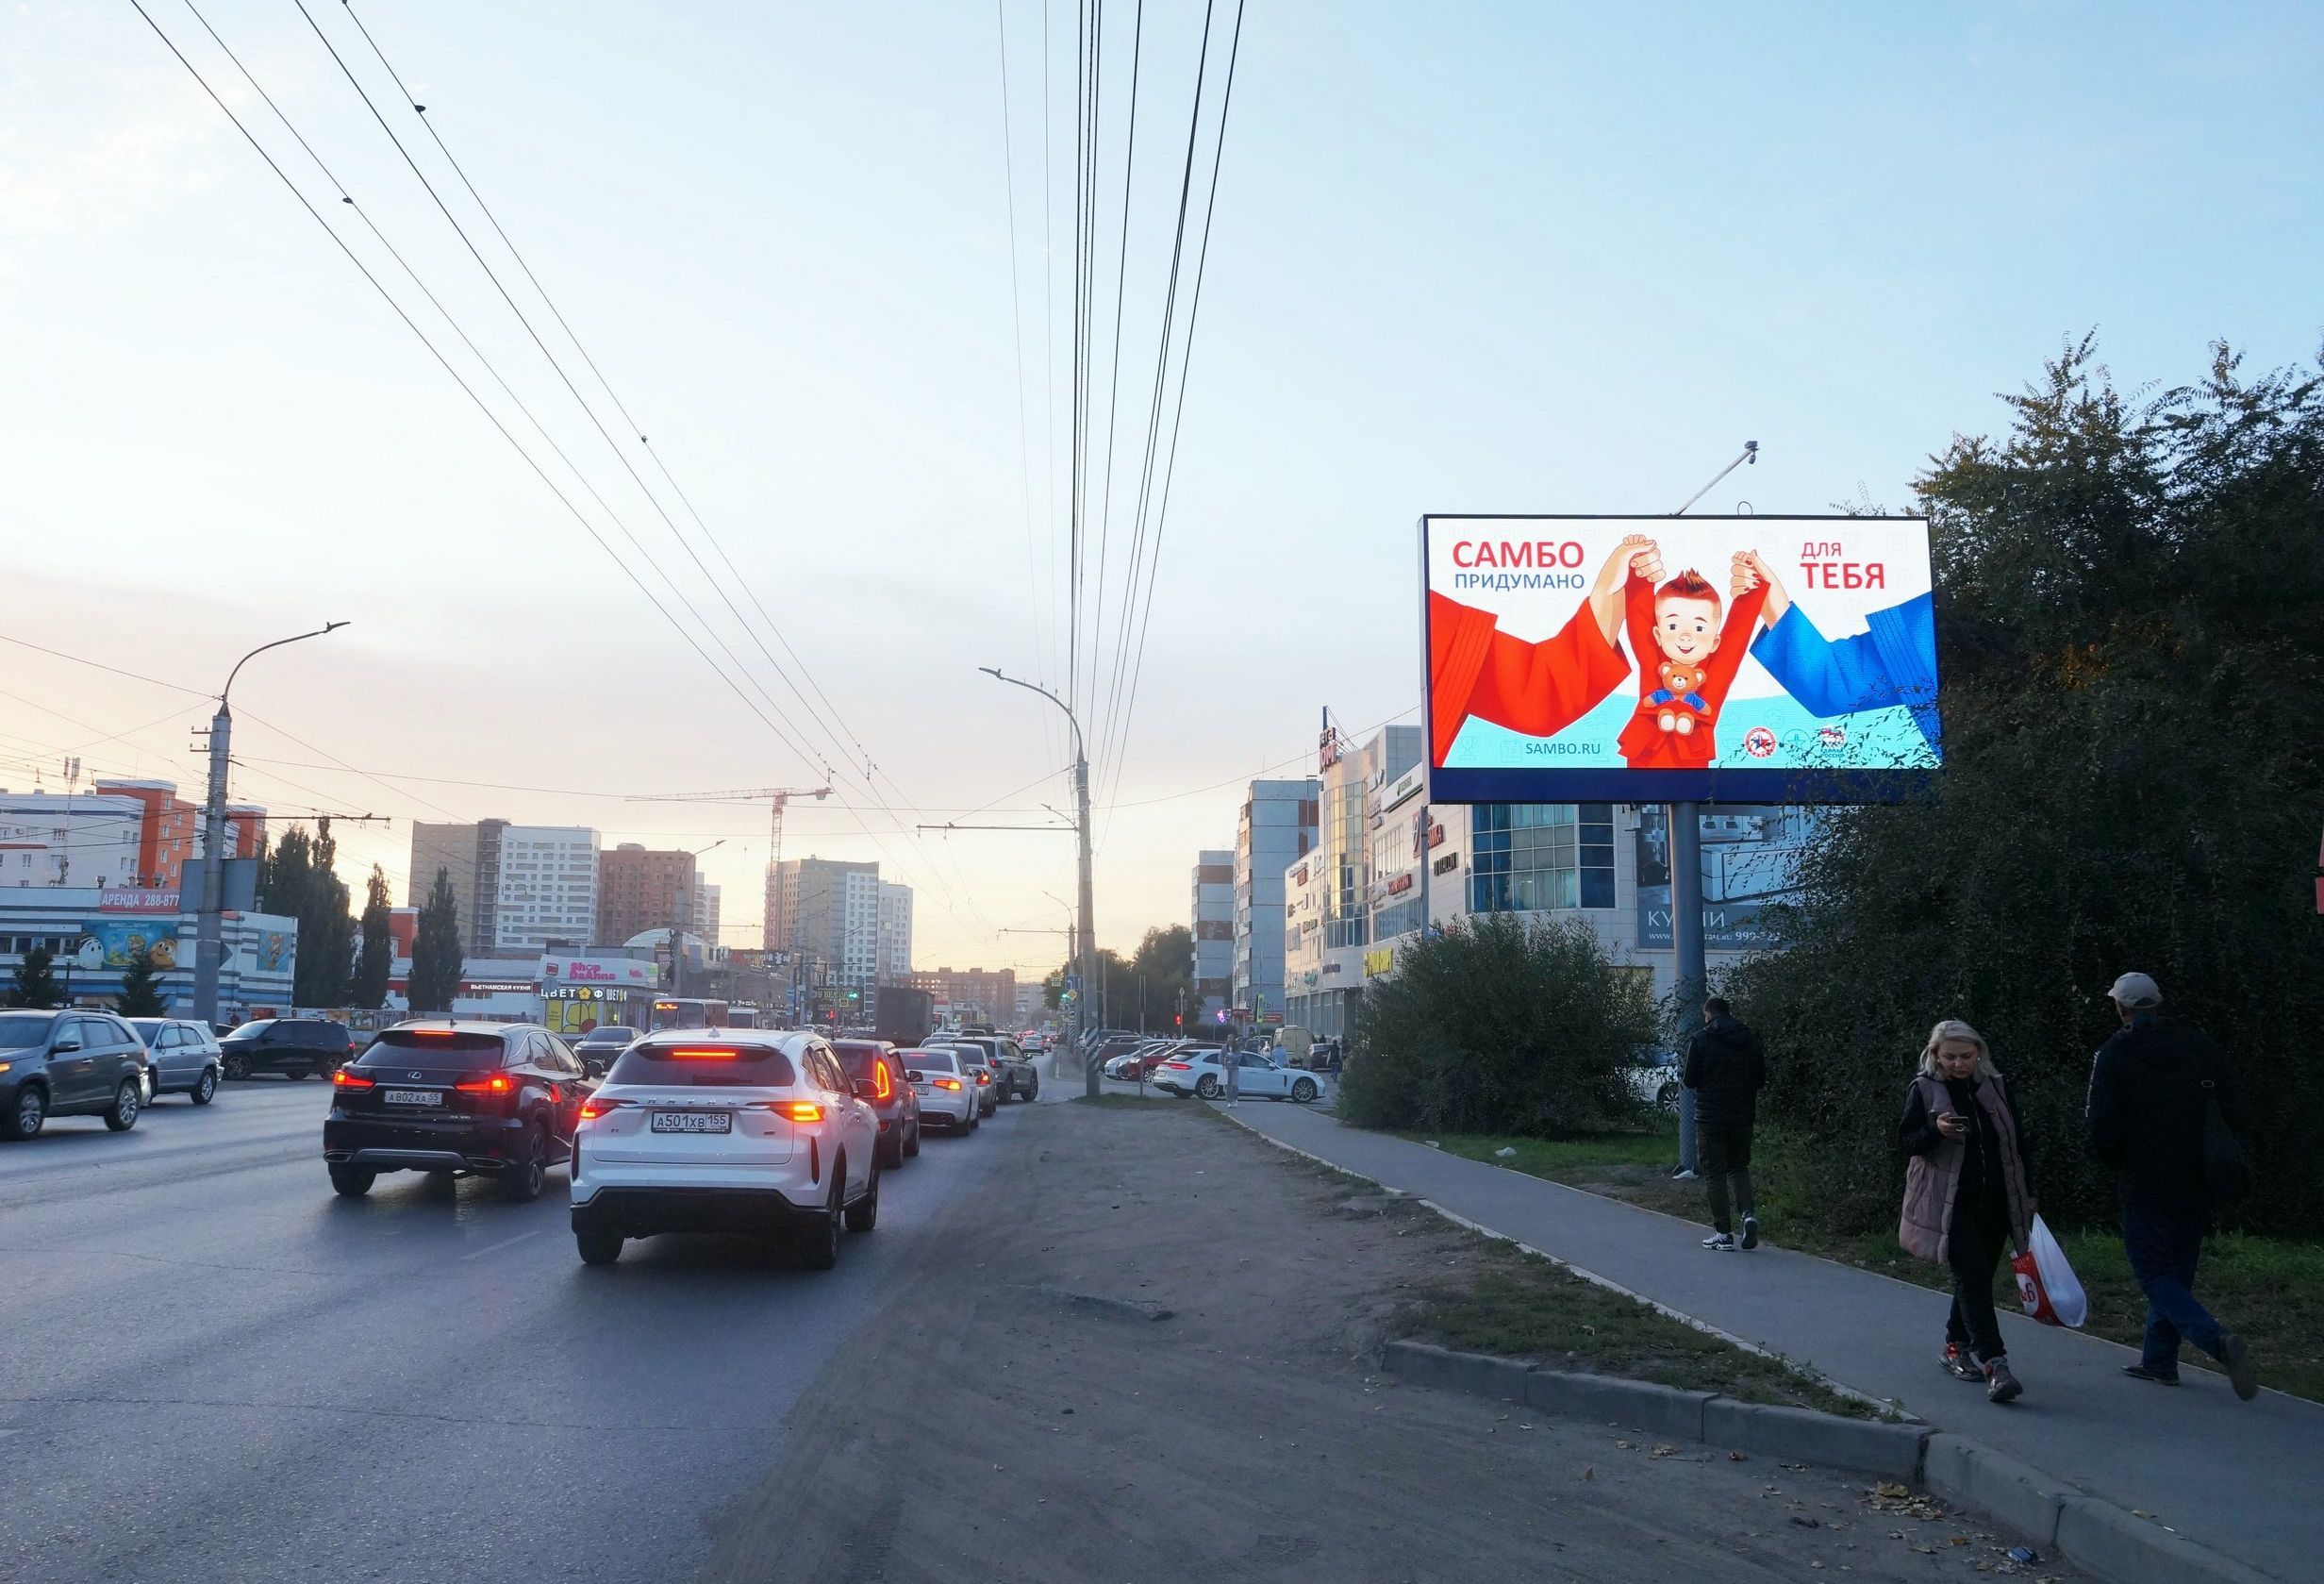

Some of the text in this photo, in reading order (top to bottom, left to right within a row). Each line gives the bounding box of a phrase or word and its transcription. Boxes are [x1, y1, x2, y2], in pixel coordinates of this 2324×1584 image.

[1452, 541, 1585, 569] САМБО
[1801, 542, 1843, 561] ДЛЯ
[1454, 573, 1585, 592] ПРИДУМАНО
[1800, 562, 1885, 590] ТЕБЯ
[1524, 741, 1602, 757] SAMBO.RU
[101, 893, 140, 908] АРЕНДА
[389, 1092, 426, 1103] А802АА
[656, 1114, 726, 1128] А501ХВ 155
